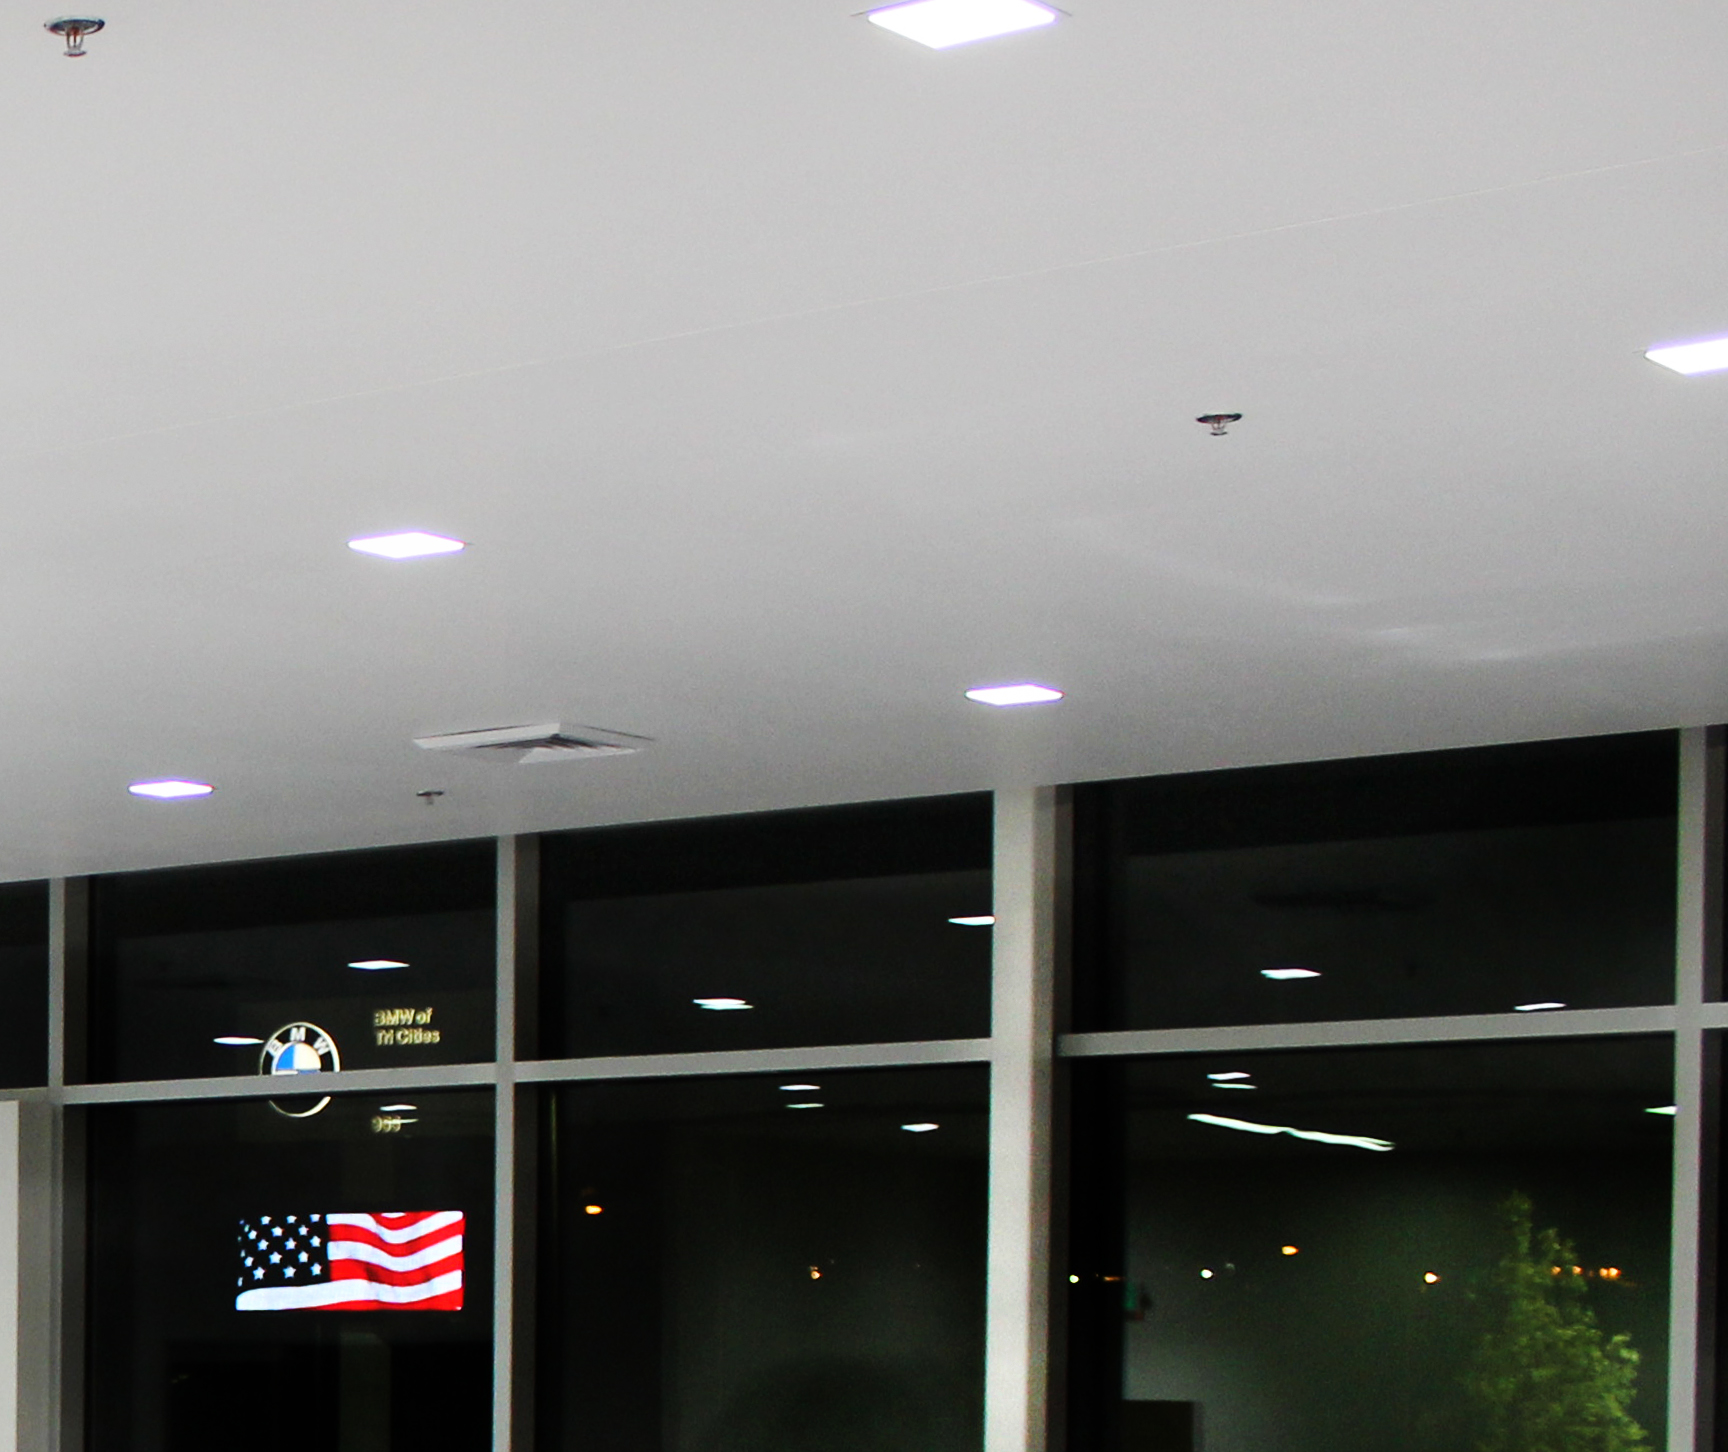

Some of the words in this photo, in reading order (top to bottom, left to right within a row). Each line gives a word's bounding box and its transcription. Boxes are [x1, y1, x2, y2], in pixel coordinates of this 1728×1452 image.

[374, 1008, 415, 1026] BMW
[416, 1007, 433, 1024] of
[396, 1028, 441, 1045] Cities
